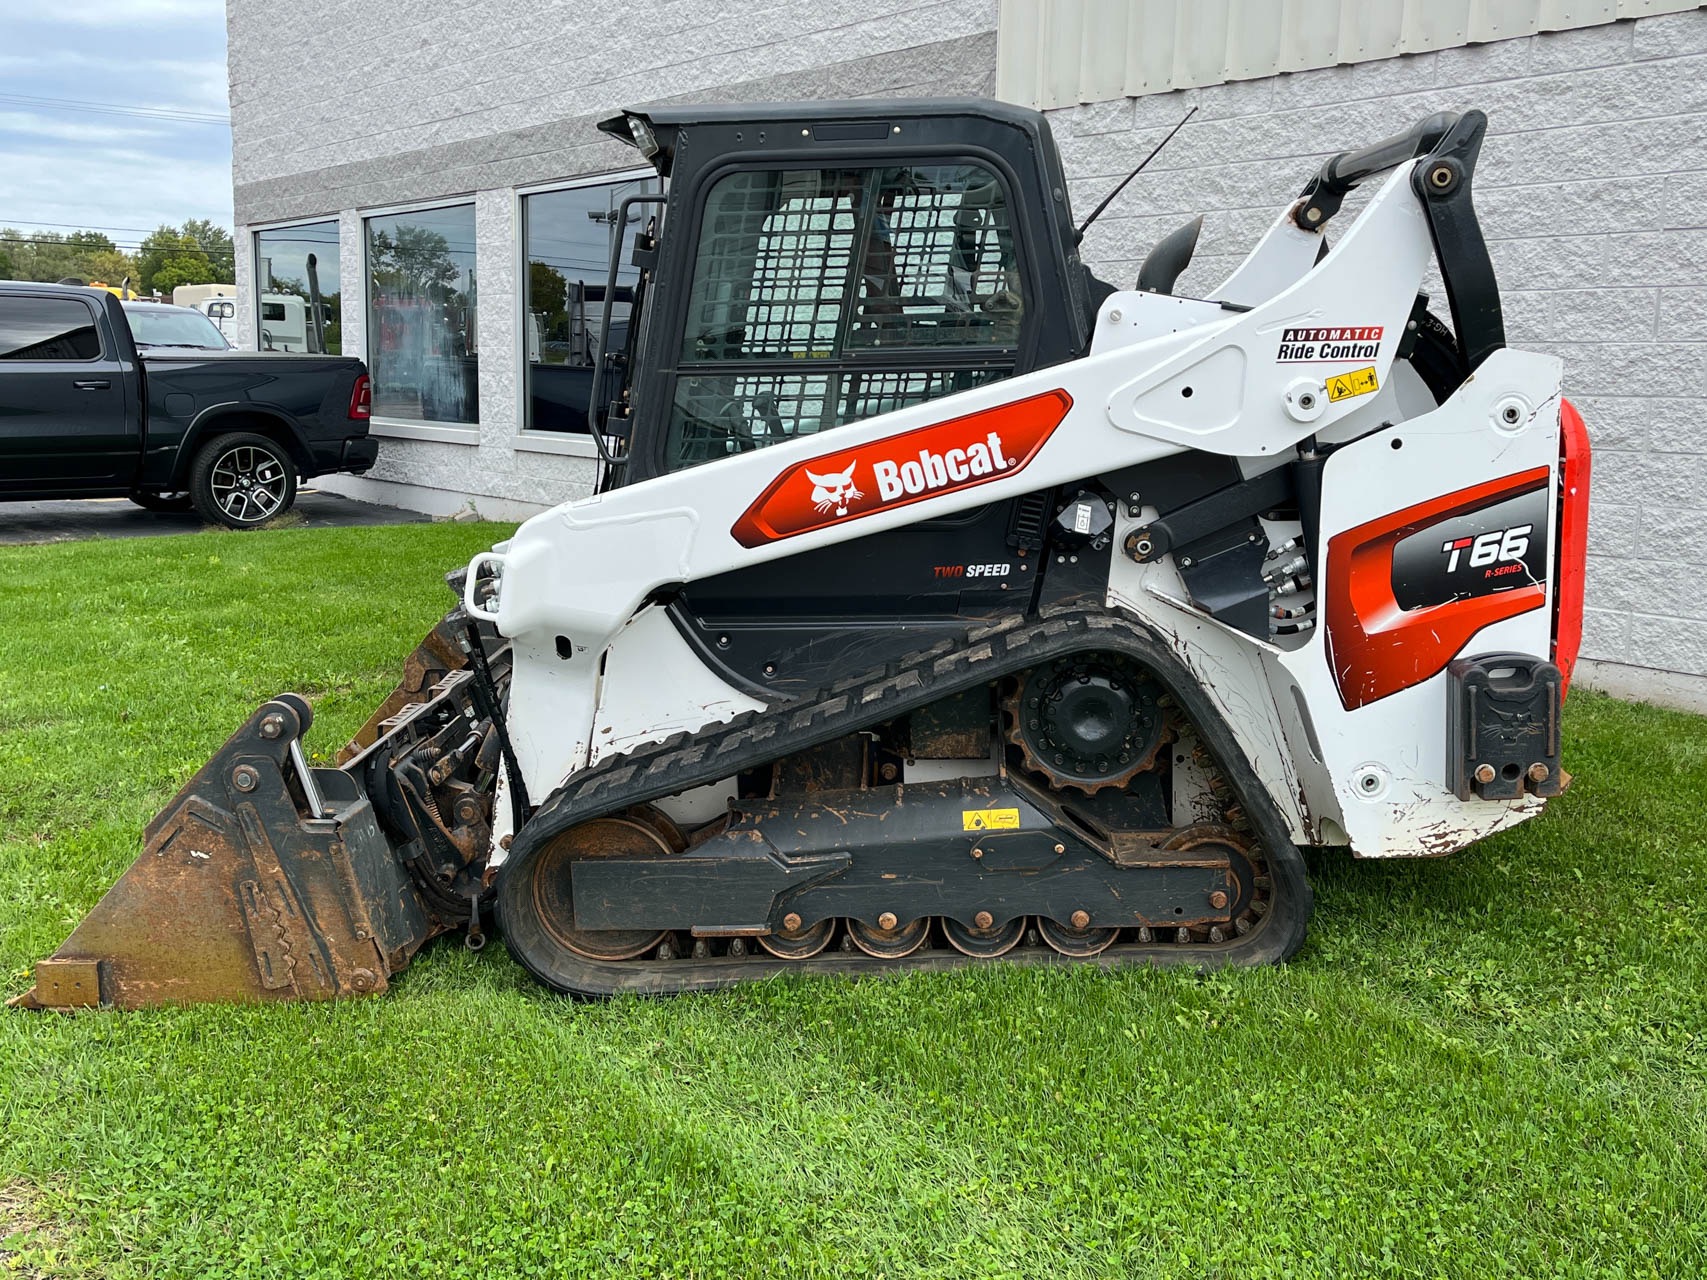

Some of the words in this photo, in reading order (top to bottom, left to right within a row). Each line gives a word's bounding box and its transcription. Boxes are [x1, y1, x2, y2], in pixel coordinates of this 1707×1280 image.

[1285, 328, 1380, 341] AUTOMATIC
[1278, 344, 1315, 360] Ride
[1319, 342, 1381, 359] Control
[873, 431, 1007, 502] Bobcat
[1442, 524, 1533, 573] T66
[934, 565, 964, 577] TWO
[966, 563, 1011, 578] SPEED
[1484, 564, 1523, 578] R-SERIES
